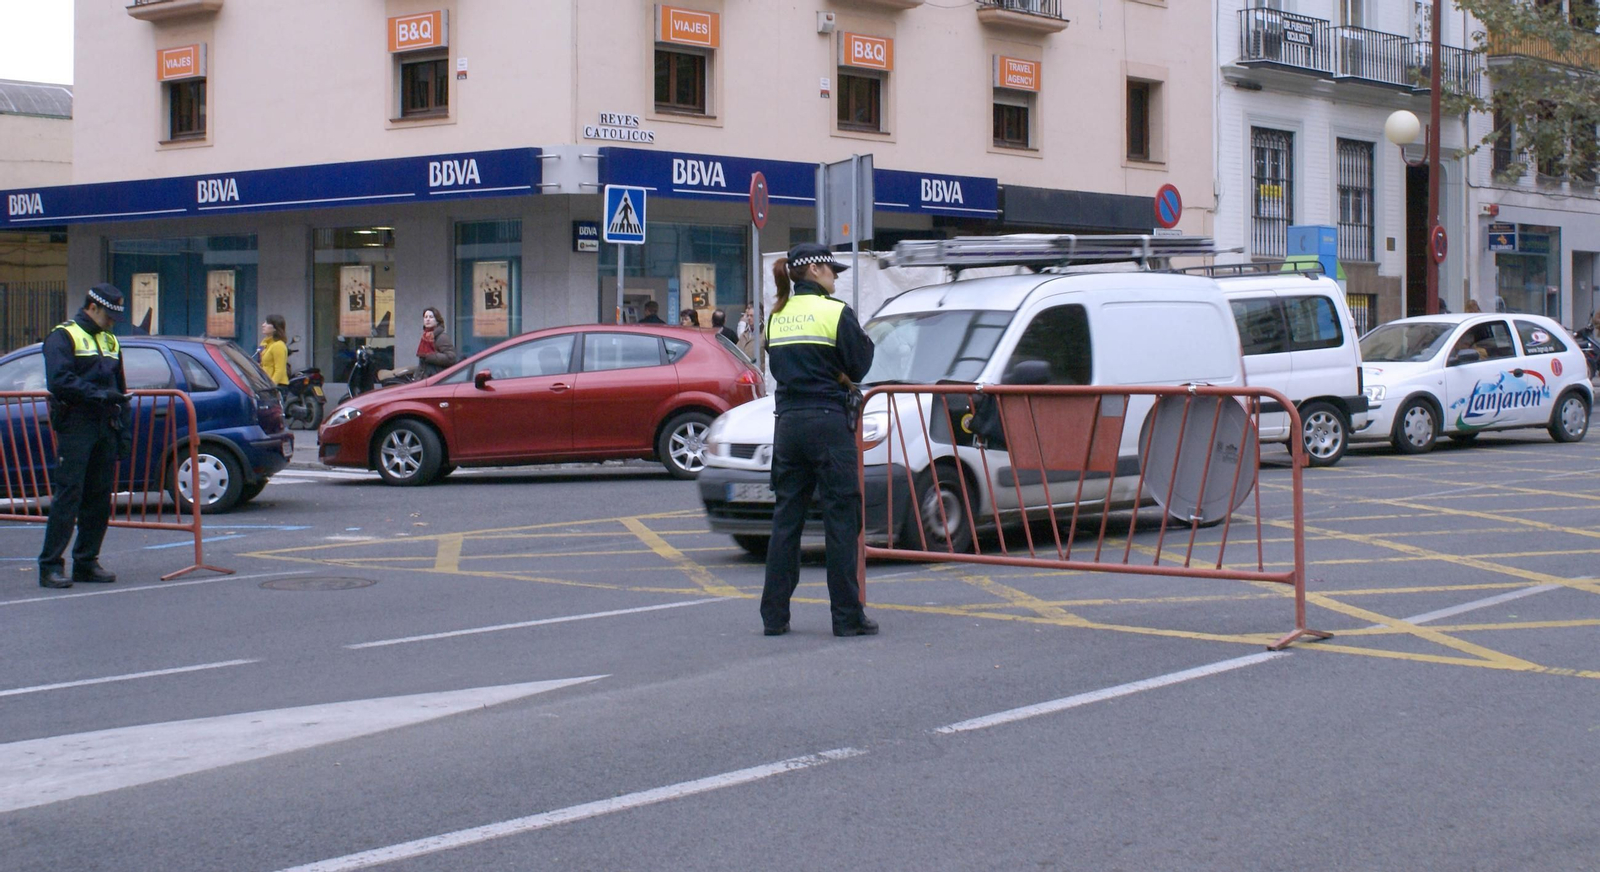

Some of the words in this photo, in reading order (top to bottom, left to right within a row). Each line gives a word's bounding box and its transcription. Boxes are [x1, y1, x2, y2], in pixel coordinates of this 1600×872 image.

[399, 20, 432, 42] B&Q
[674, 19, 708, 35] VIAJES
[1291, 21, 1312, 34] FUENTES
[1286, 31, 1310, 44] OCULISTA
[854, 40, 884, 62] B&Q
[165, 56, 191, 69] VIAJES
[1009, 62, 1032, 74] TRAVEL
[1007, 74, 1033, 86] AGENCY
[600, 113, 639, 127] REYES
[585, 126, 655, 141] CATOLICOS
[429, 158, 481, 187] BBVA
[673, 158, 726, 187] BBVA
[197, 178, 240, 204] BBVA
[921, 178, 964, 204] BBVA
[8, 193, 44, 216] BBVA
[579, 226, 598, 236] BBVA
[222, 297, 228, 310] 5
[356, 294, 363, 308] 5
[492, 291, 500, 306] 5
[699, 293, 706, 307] 5
[773, 314, 815, 325] POLICIA
[780, 325, 804, 333] LOCAL
[1464, 379, 1541, 418] Lanjarón
